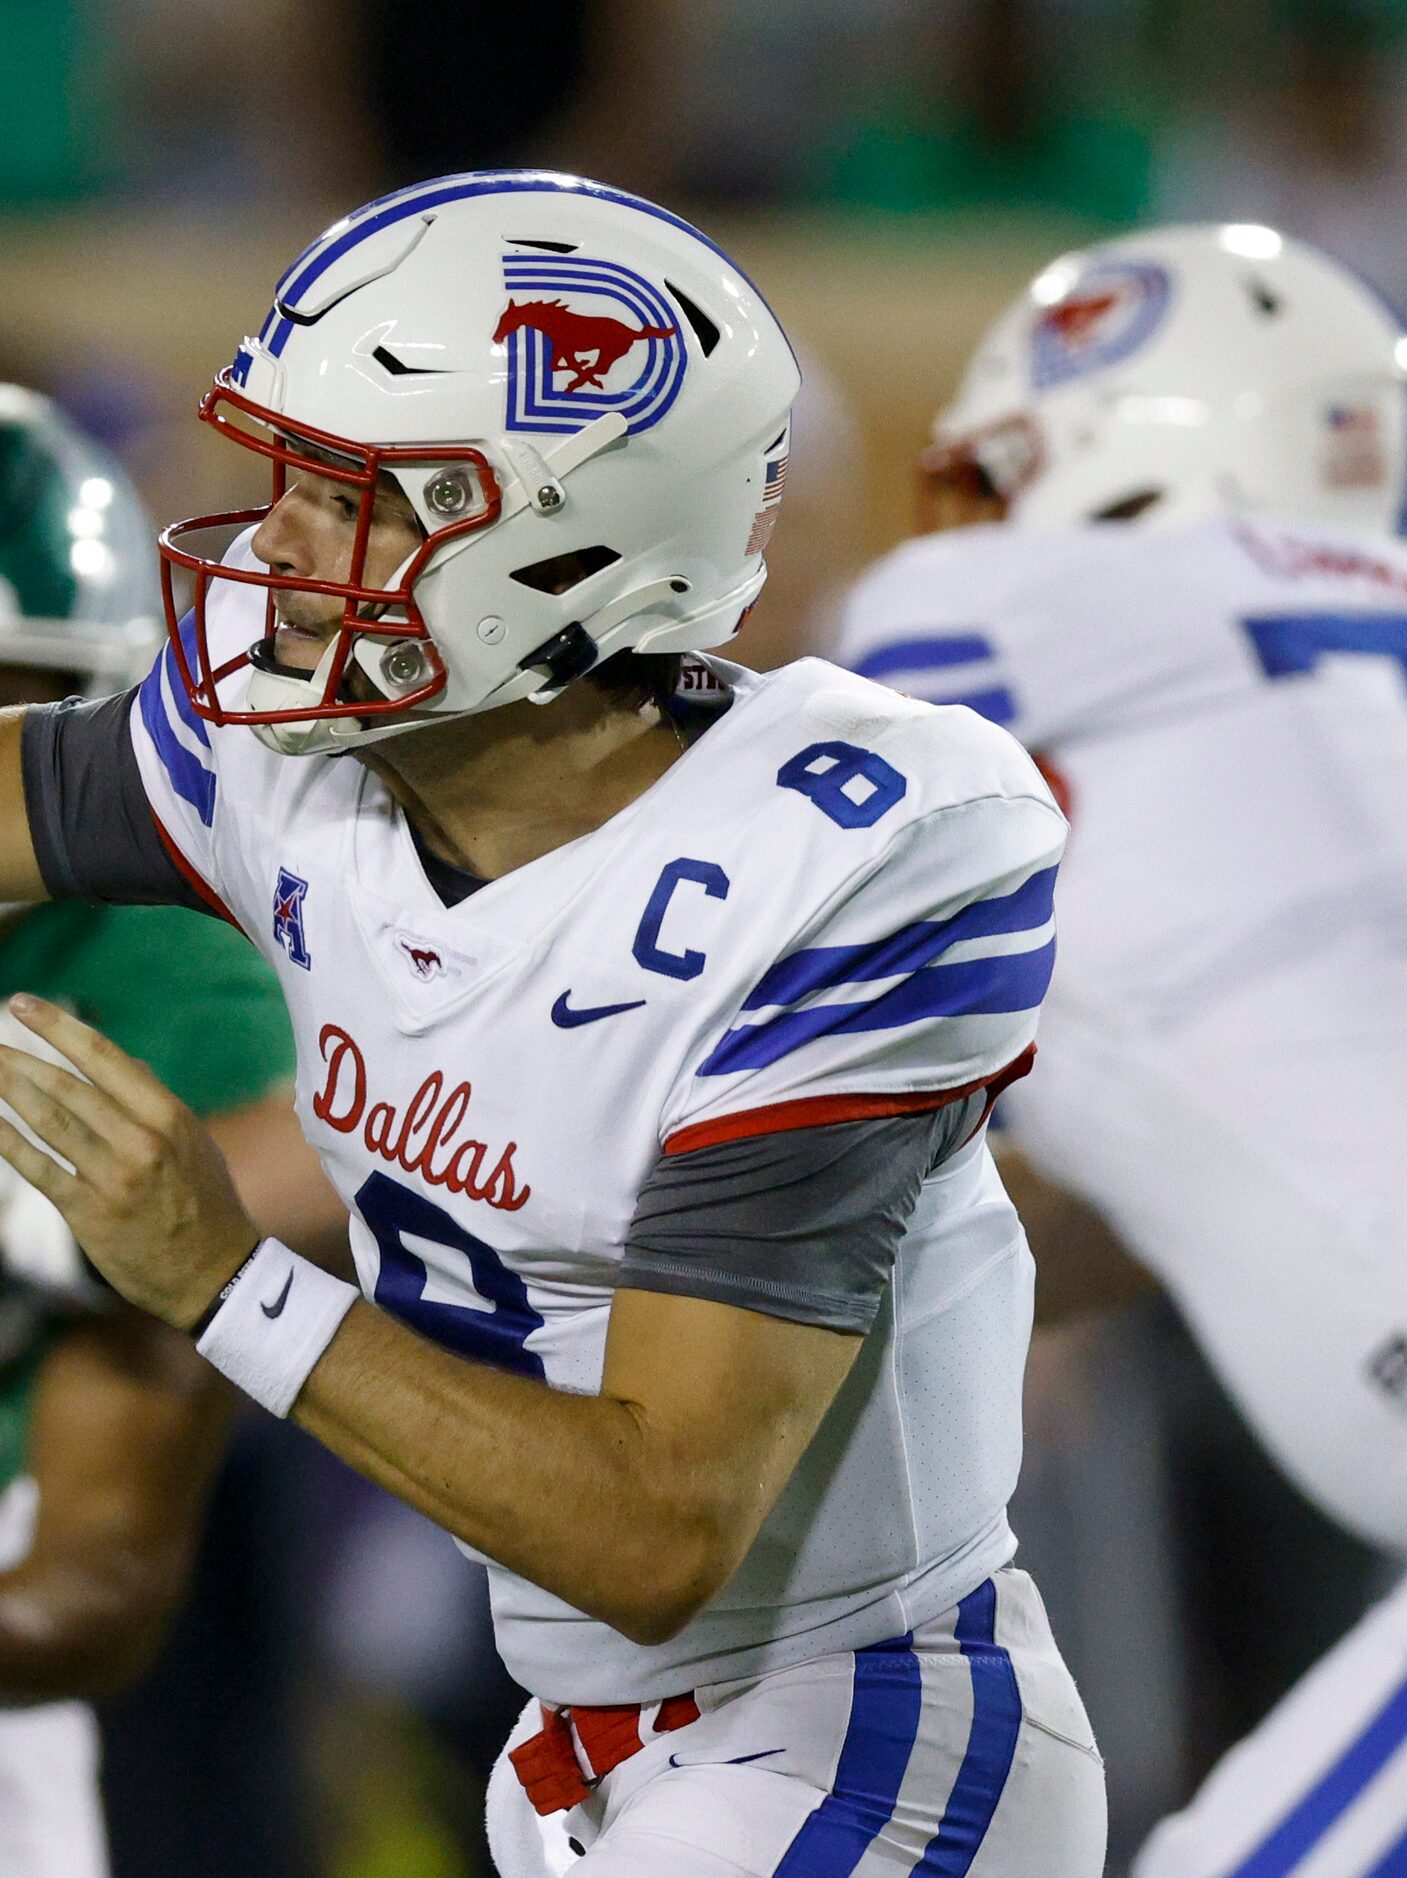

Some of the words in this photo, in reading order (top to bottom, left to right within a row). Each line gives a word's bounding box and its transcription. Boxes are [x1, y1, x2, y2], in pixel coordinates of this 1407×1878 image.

[776, 740, 908, 830] 8
[632, 857, 730, 981] C
[313, 1023, 531, 1211] Dallas
